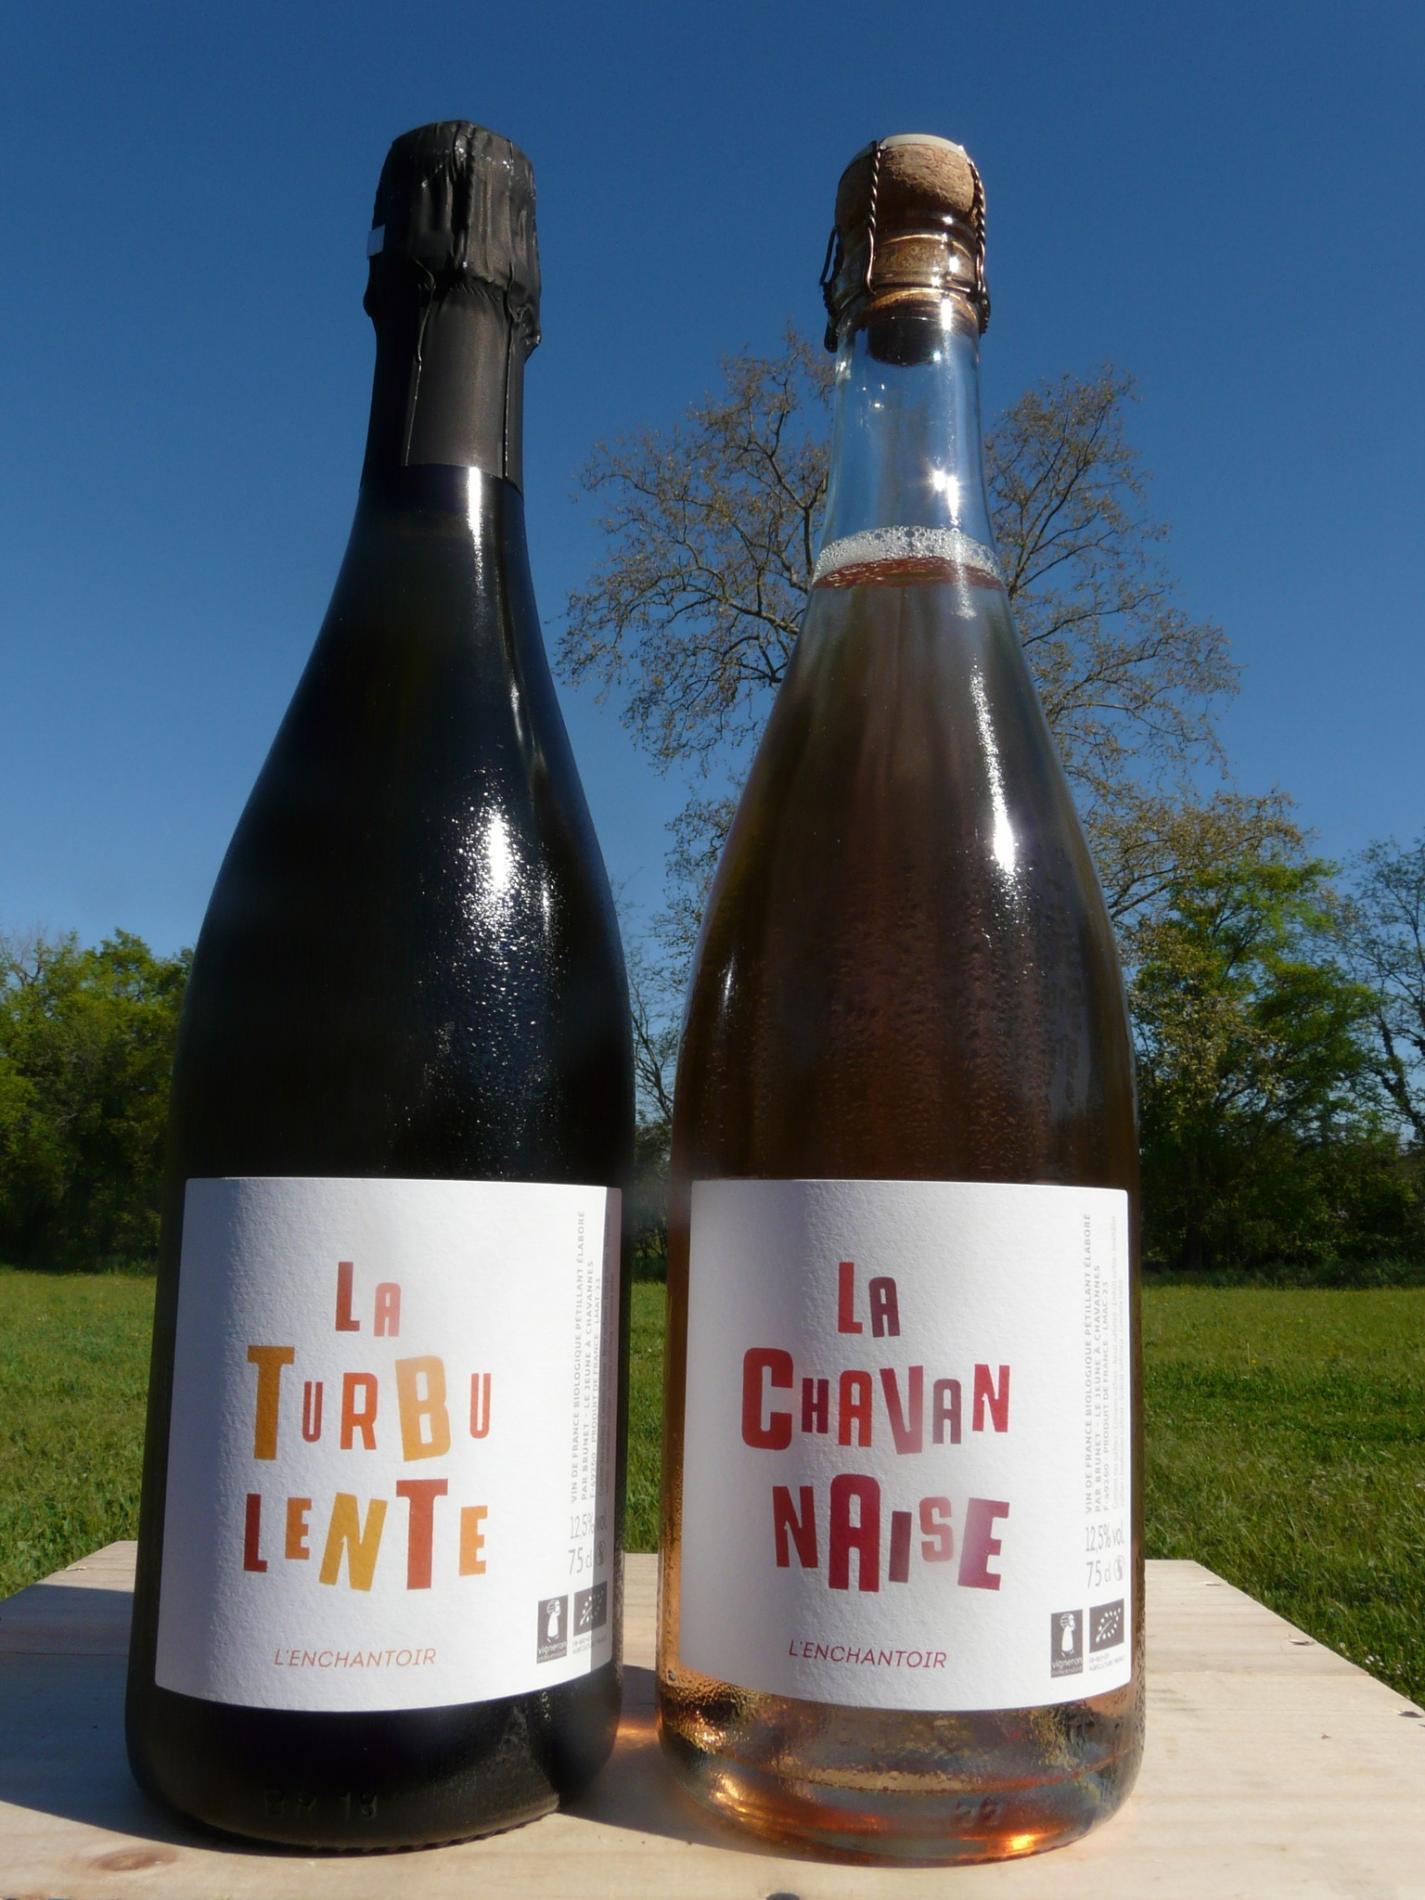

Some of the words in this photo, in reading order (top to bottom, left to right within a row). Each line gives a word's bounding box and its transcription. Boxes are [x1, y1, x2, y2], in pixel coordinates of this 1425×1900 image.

[335, 1261, 402, 1337] LA
[837, 1261, 901, 1338] LA
[572, 1335, 582, 1408] BIOLOGIQUE
[1084, 1341, 1093, 1416] BIOLOGIQUE
[247, 1344, 492, 1462] TURBU
[741, 1347, 1011, 1455] CHAVAN
[571, 1412, 579, 1459] FRANCE
[581, 1423, 590, 1472] BRUNET
[1084, 1421, 1092, 1469] FRANCE
[1094, 1433, 1102, 1482] BRUNET
[570, 1463, 578, 1478] DE
[570, 1482, 578, 1503] VIN
[1084, 1473, 1092, 1488] DE
[1084, 1492, 1092, 1514] VIN
[1094, 1488, 1102, 1512] PAR
[243, 1478, 489, 1592] LENTE
[772, 1473, 1011, 1592] NAISE
[273, 1647, 437, 1668] L'ENCHANTOIR
[788, 1639, 948, 1669] L'ENCHANTOIR
